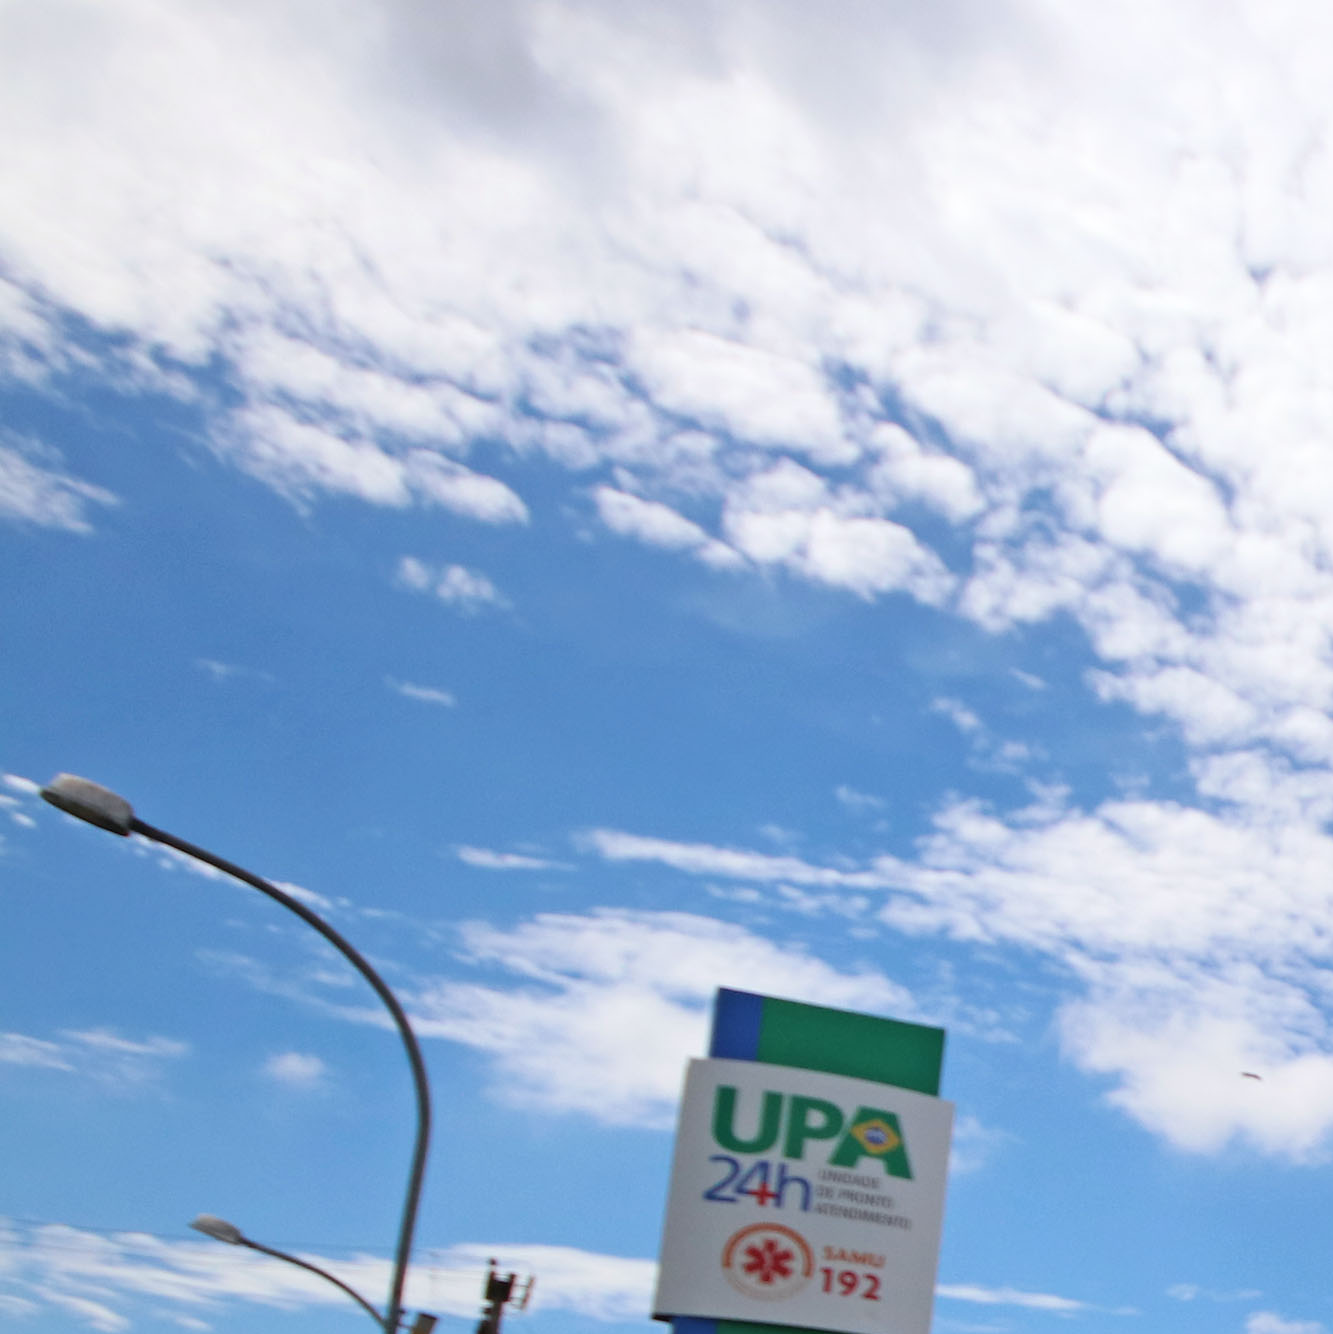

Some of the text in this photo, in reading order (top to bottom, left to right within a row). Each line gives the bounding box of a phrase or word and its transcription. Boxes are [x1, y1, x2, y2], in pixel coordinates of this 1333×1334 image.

[711, 1084, 914, 1181] UPA
[703, 1154, 813, 1213] 24h
[823, 1245, 886, 1269] SAMU
[819, 1267, 882, 1301] 192
